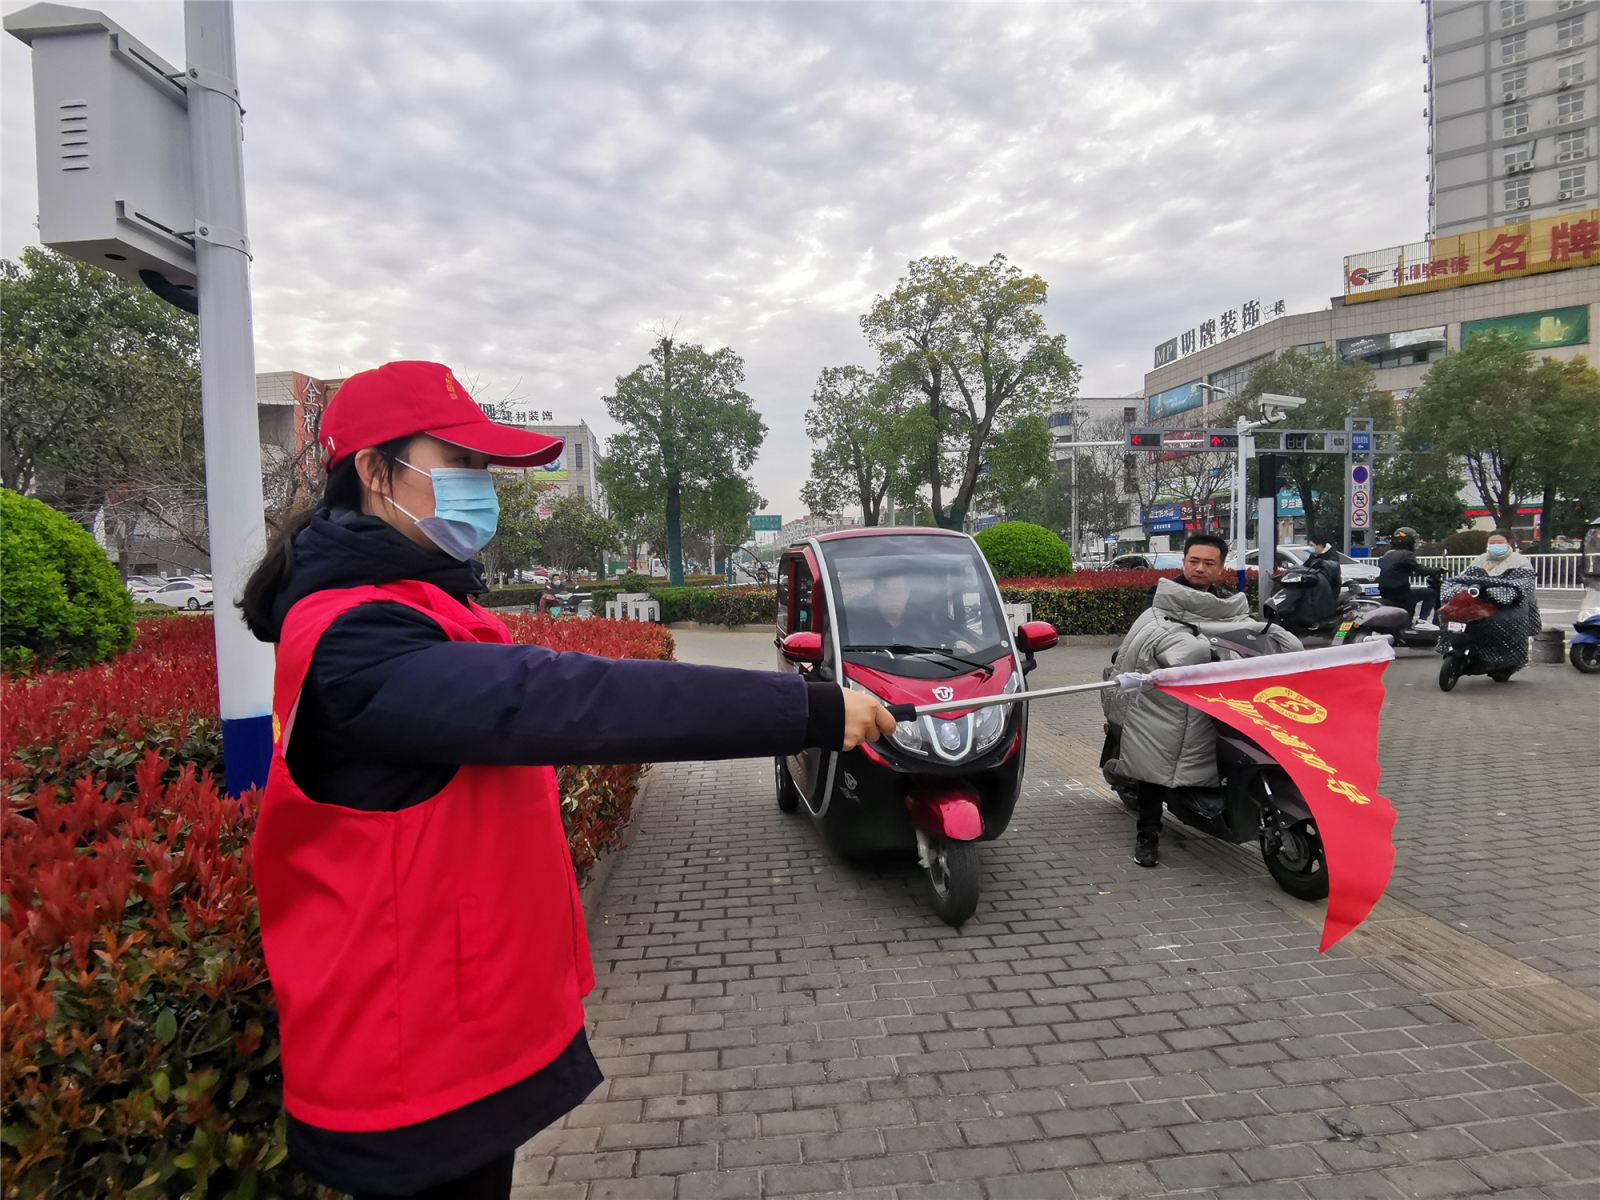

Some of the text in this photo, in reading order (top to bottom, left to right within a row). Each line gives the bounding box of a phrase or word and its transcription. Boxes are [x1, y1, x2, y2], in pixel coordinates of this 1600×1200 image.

[1483, 219, 1600, 274] 名牌
[1155, 344, 1173, 366] MP
[1181, 299, 1260, 356] 明牌装饰
